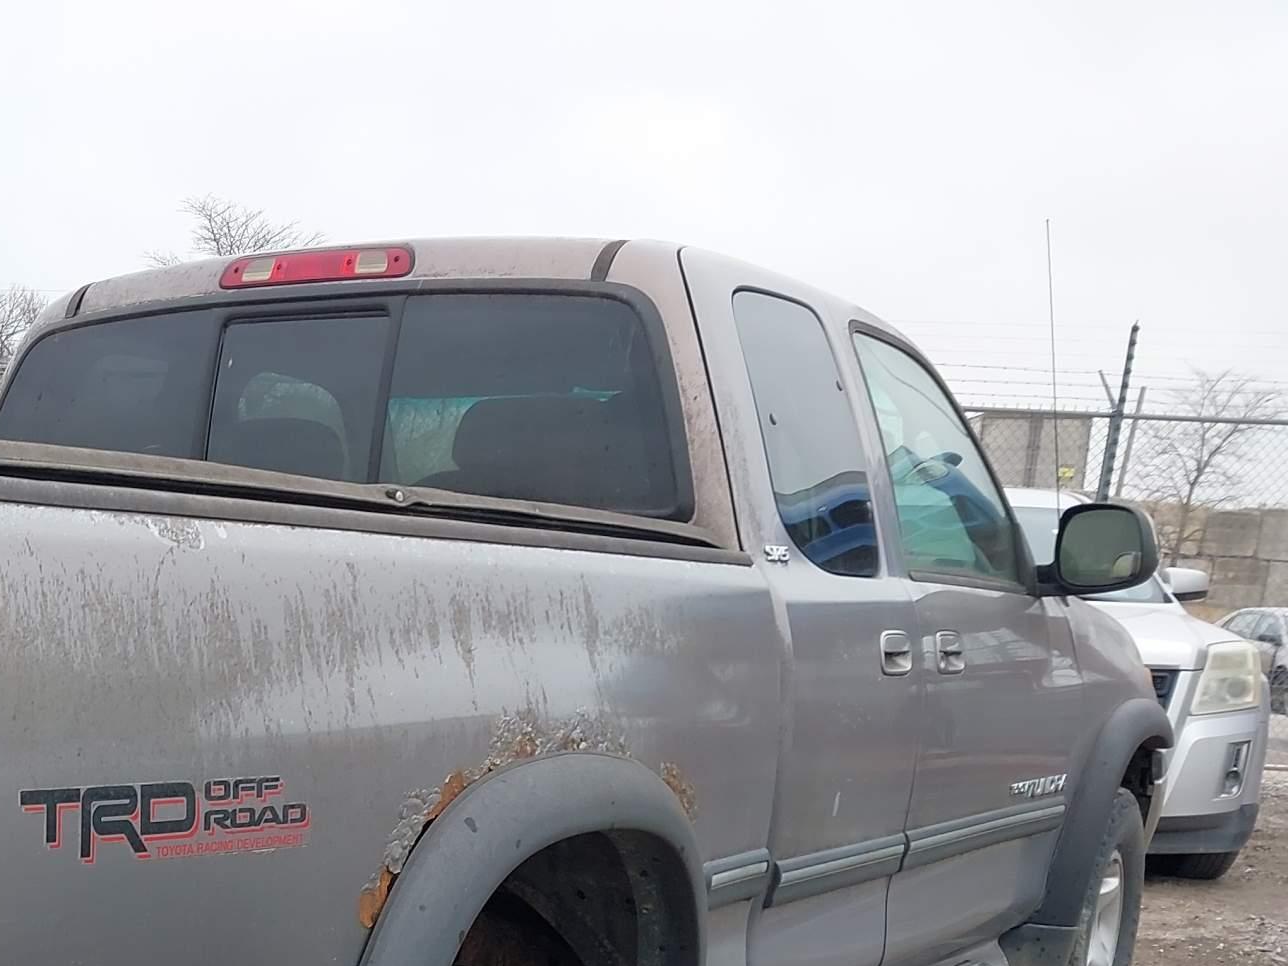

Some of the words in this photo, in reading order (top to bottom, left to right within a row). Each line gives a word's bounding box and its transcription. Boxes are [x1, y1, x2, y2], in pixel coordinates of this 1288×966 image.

[204, 775, 284, 806] OFF
[18, 780, 200, 863] TRD
[203, 802, 311, 836] ROAD
[156, 845, 194, 858] TOYOTA
[196, 840, 233, 854] RACING
[236, 833, 304, 850] DEVELOPMENT
